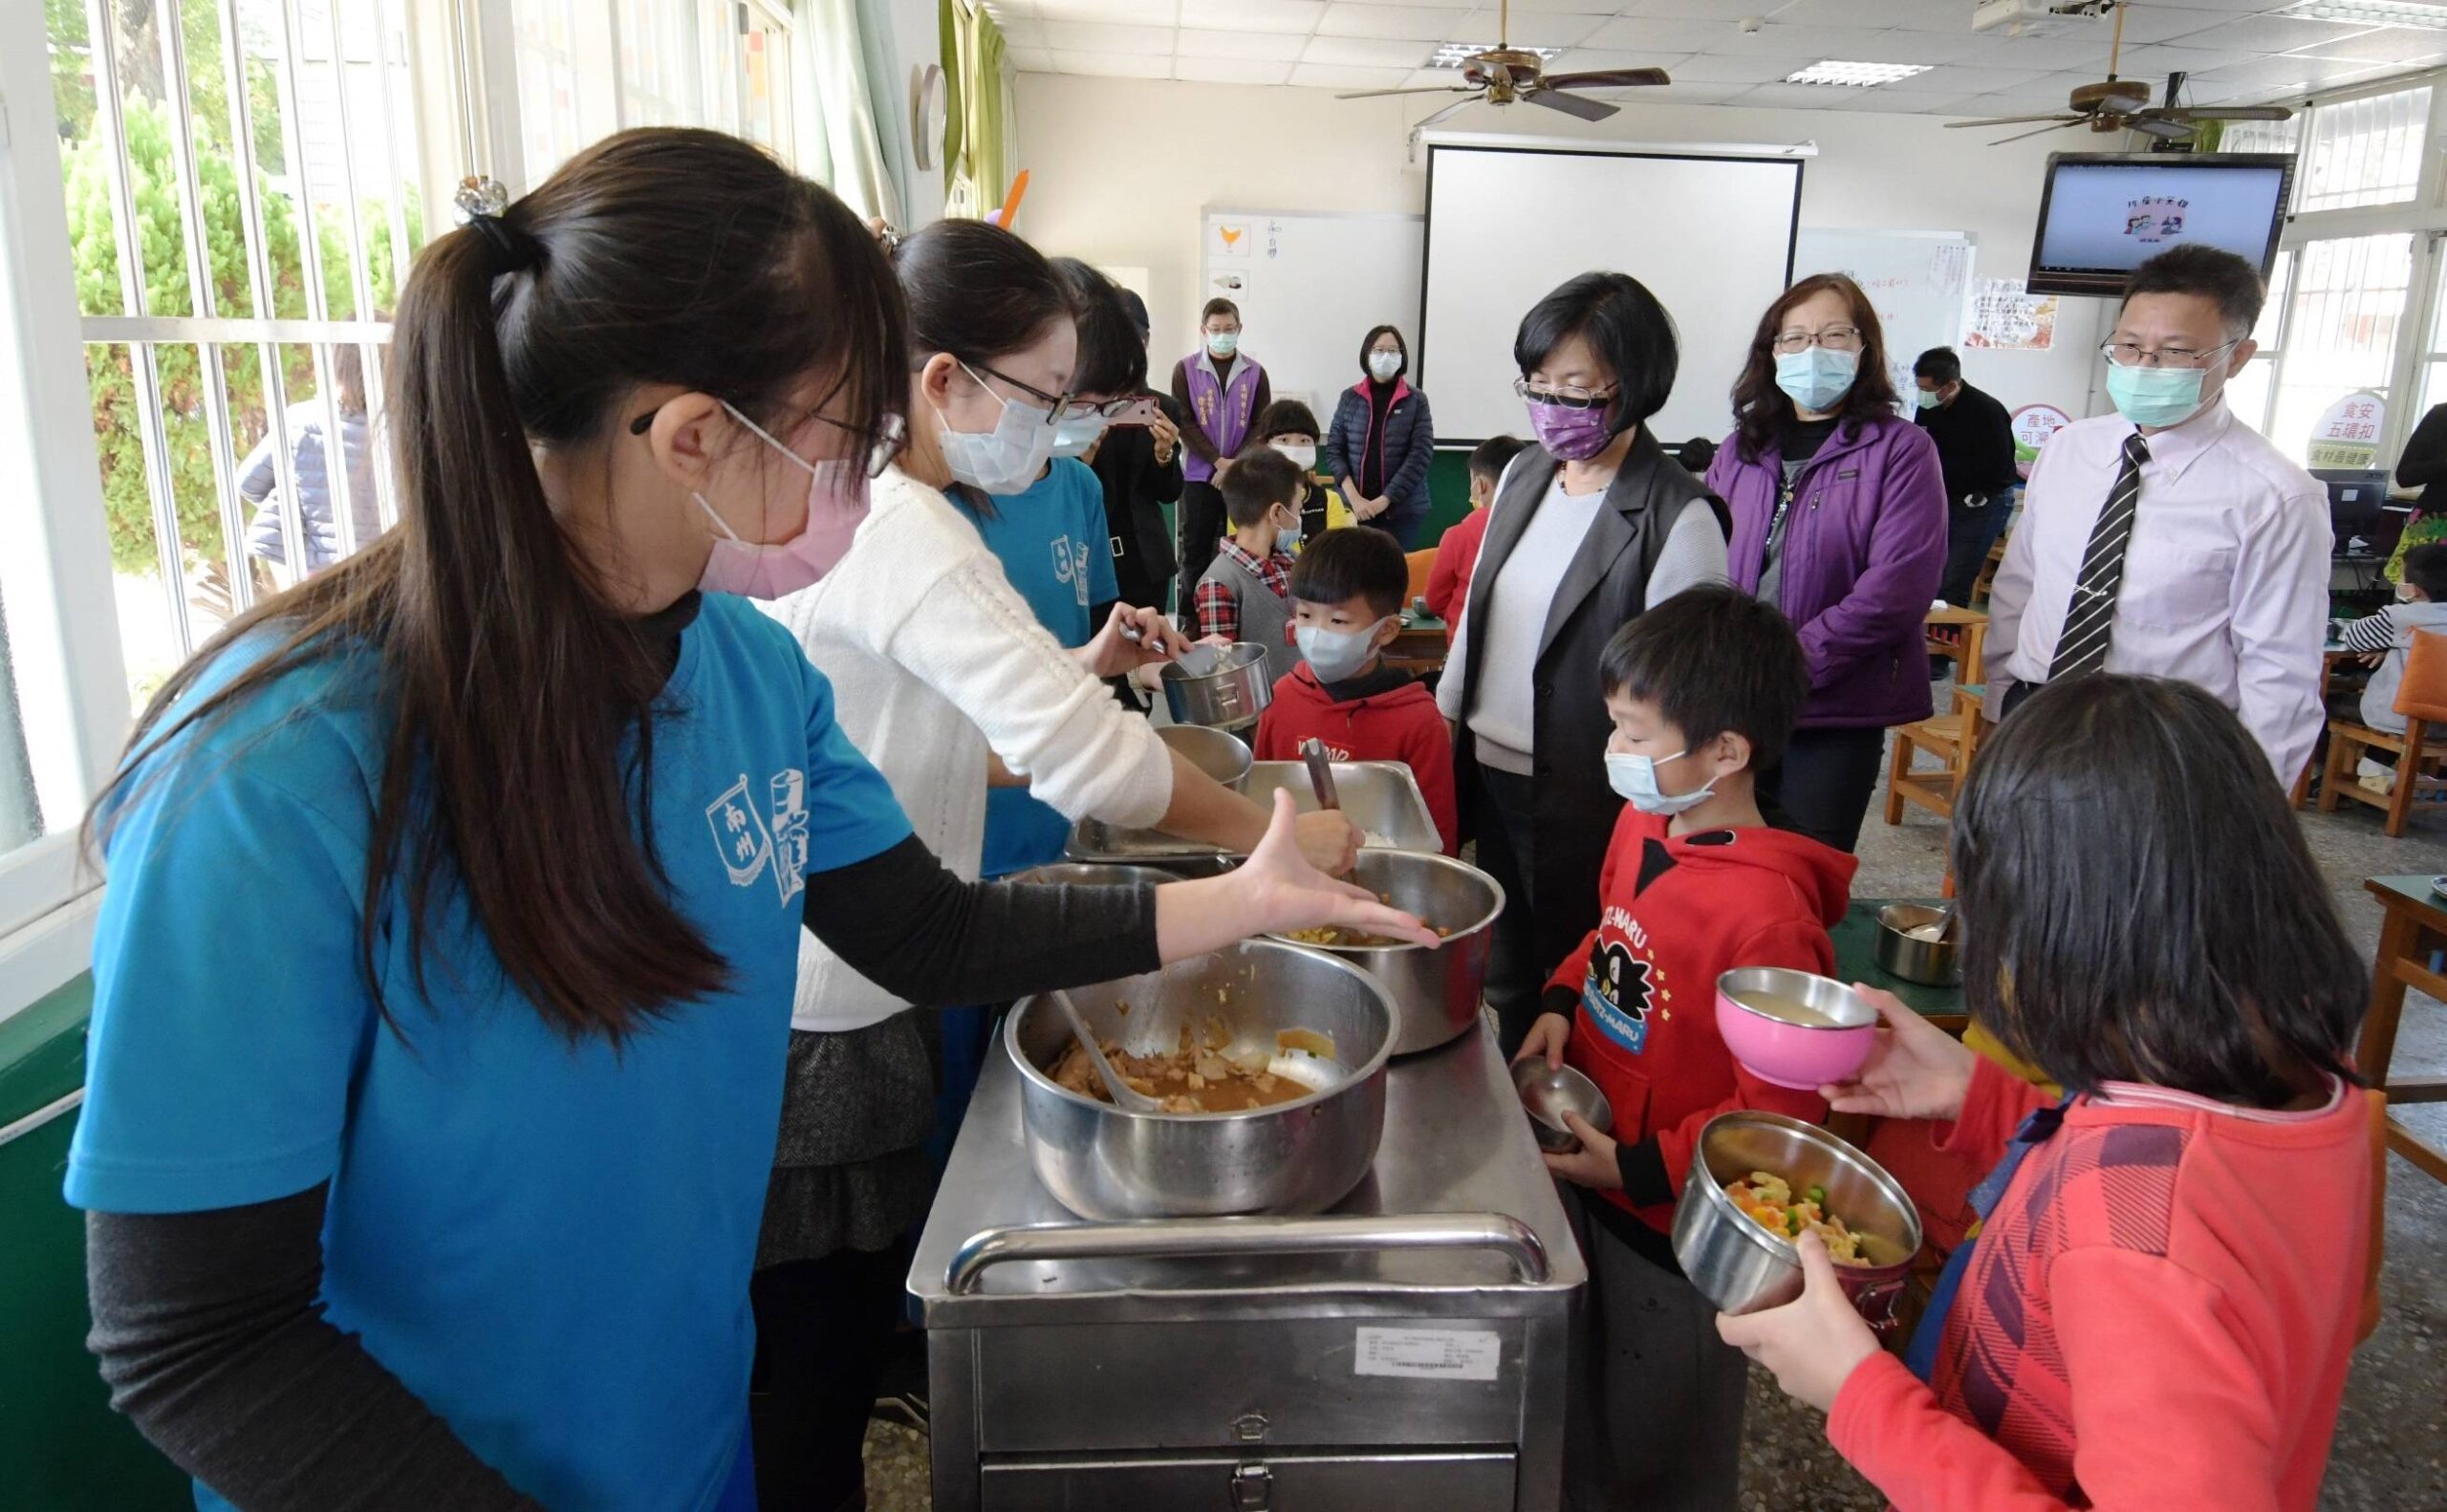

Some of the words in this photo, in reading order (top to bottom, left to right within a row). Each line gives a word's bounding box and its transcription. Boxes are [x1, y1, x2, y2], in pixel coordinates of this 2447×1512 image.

[2343, 401, 2375, 419] 食安
[2027, 414, 2055, 428] 產地
[2327, 421, 2375, 440] 五環扣
